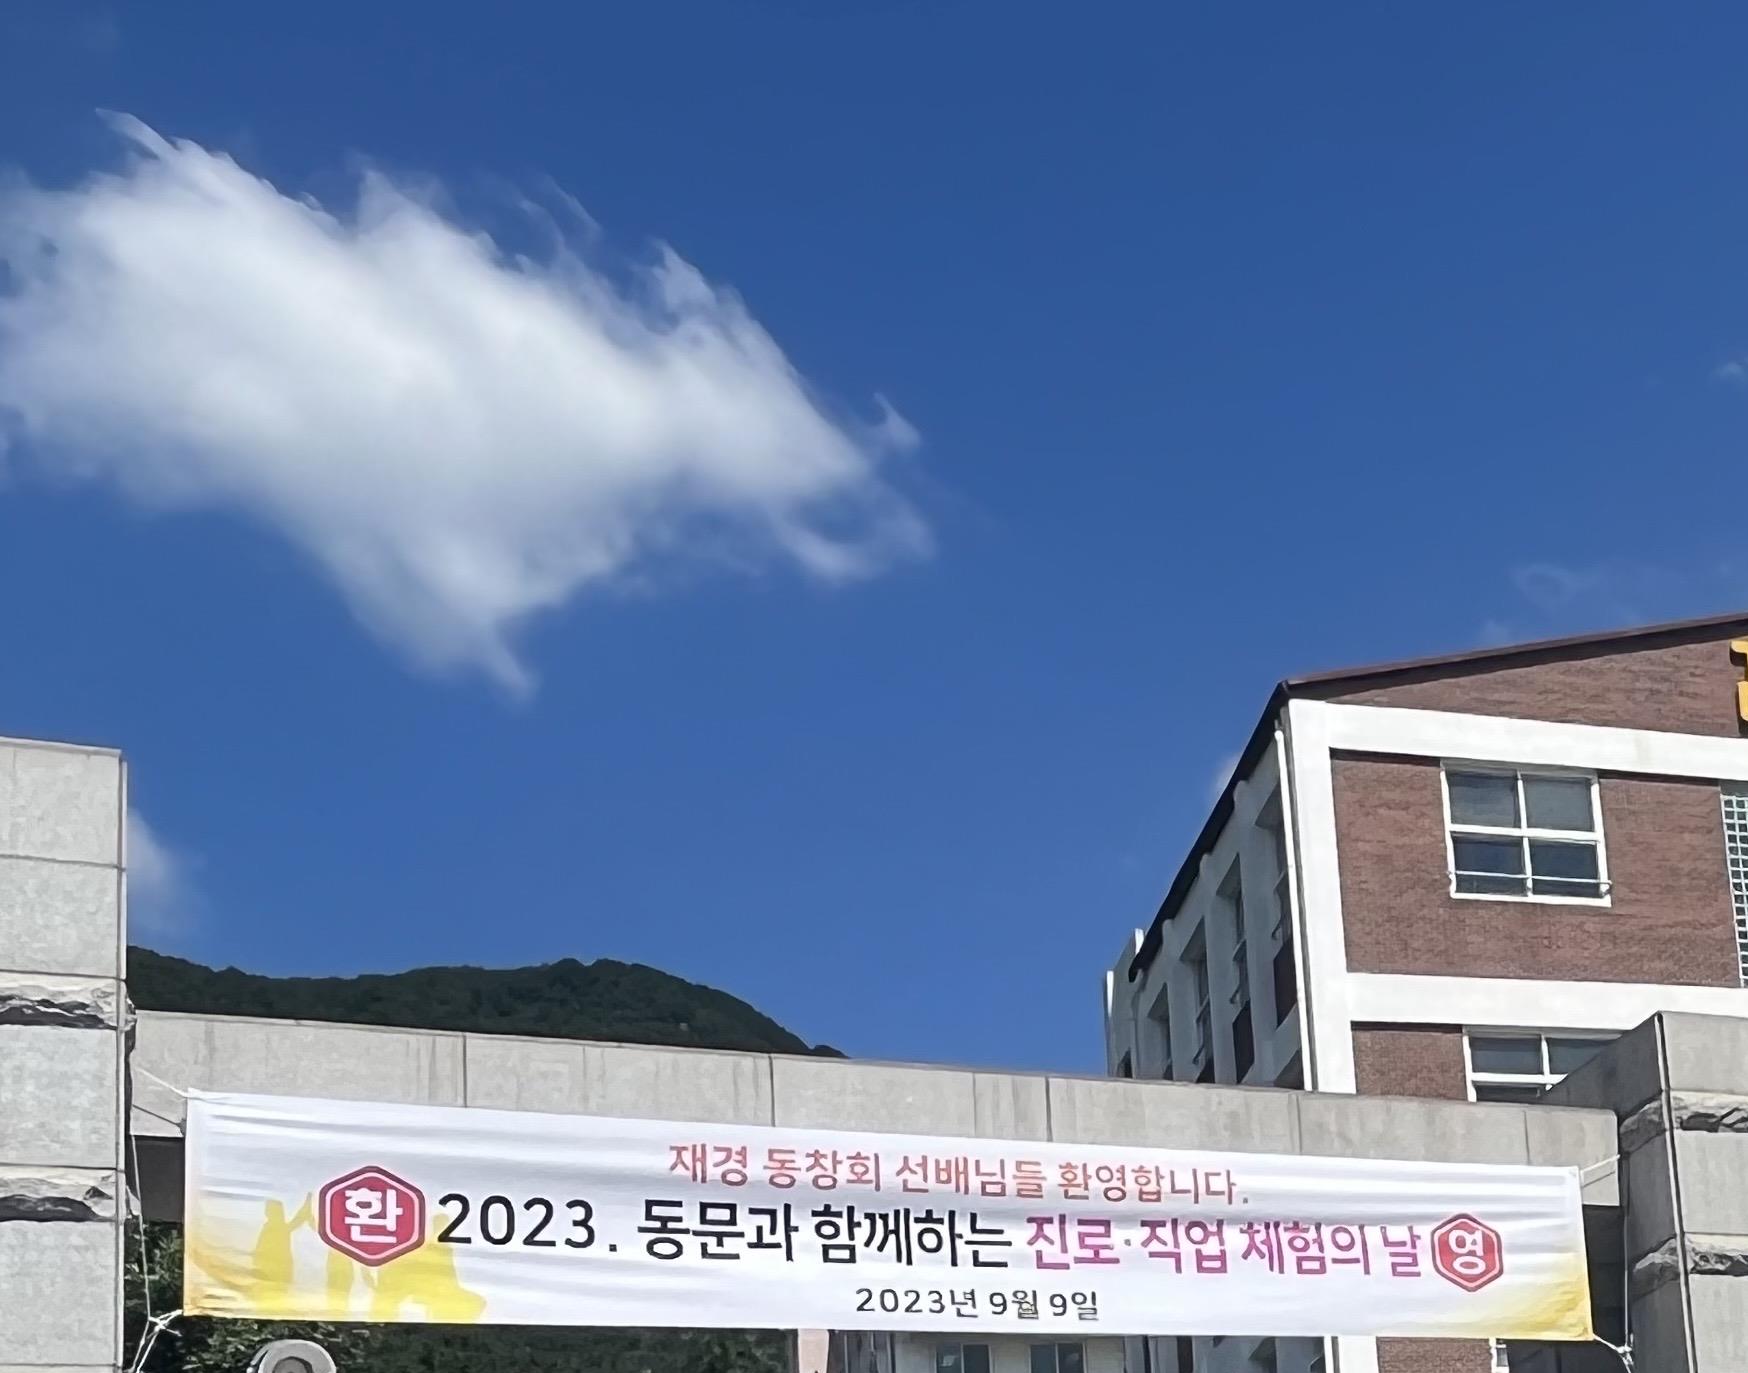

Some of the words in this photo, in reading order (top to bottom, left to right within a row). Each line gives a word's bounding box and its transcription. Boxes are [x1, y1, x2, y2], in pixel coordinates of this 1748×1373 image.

[669, 1143, 748, 1187] 재경
[763, 1149, 881, 1192] 동창회
[896, 1154, 1048, 1198] 선배님들
[1058, 1161, 1249, 1206] 환영합니다.
[344, 1187, 403, 1244] 환
[437, 1192, 618, 1252] 2023.
[637, 1198, 799, 1262] 동문과
[811, 1203, 1013, 1268] 함께하는
[1240, 1220, 1371, 1277] 체험의
[1379, 1224, 1422, 1277] 날
[1448, 1229, 1485, 1276] 영
[855, 1288, 978, 1317] 2023년
[989, 1289, 1039, 1320] 9월
[1049, 1290, 1099, 1321] 9일
